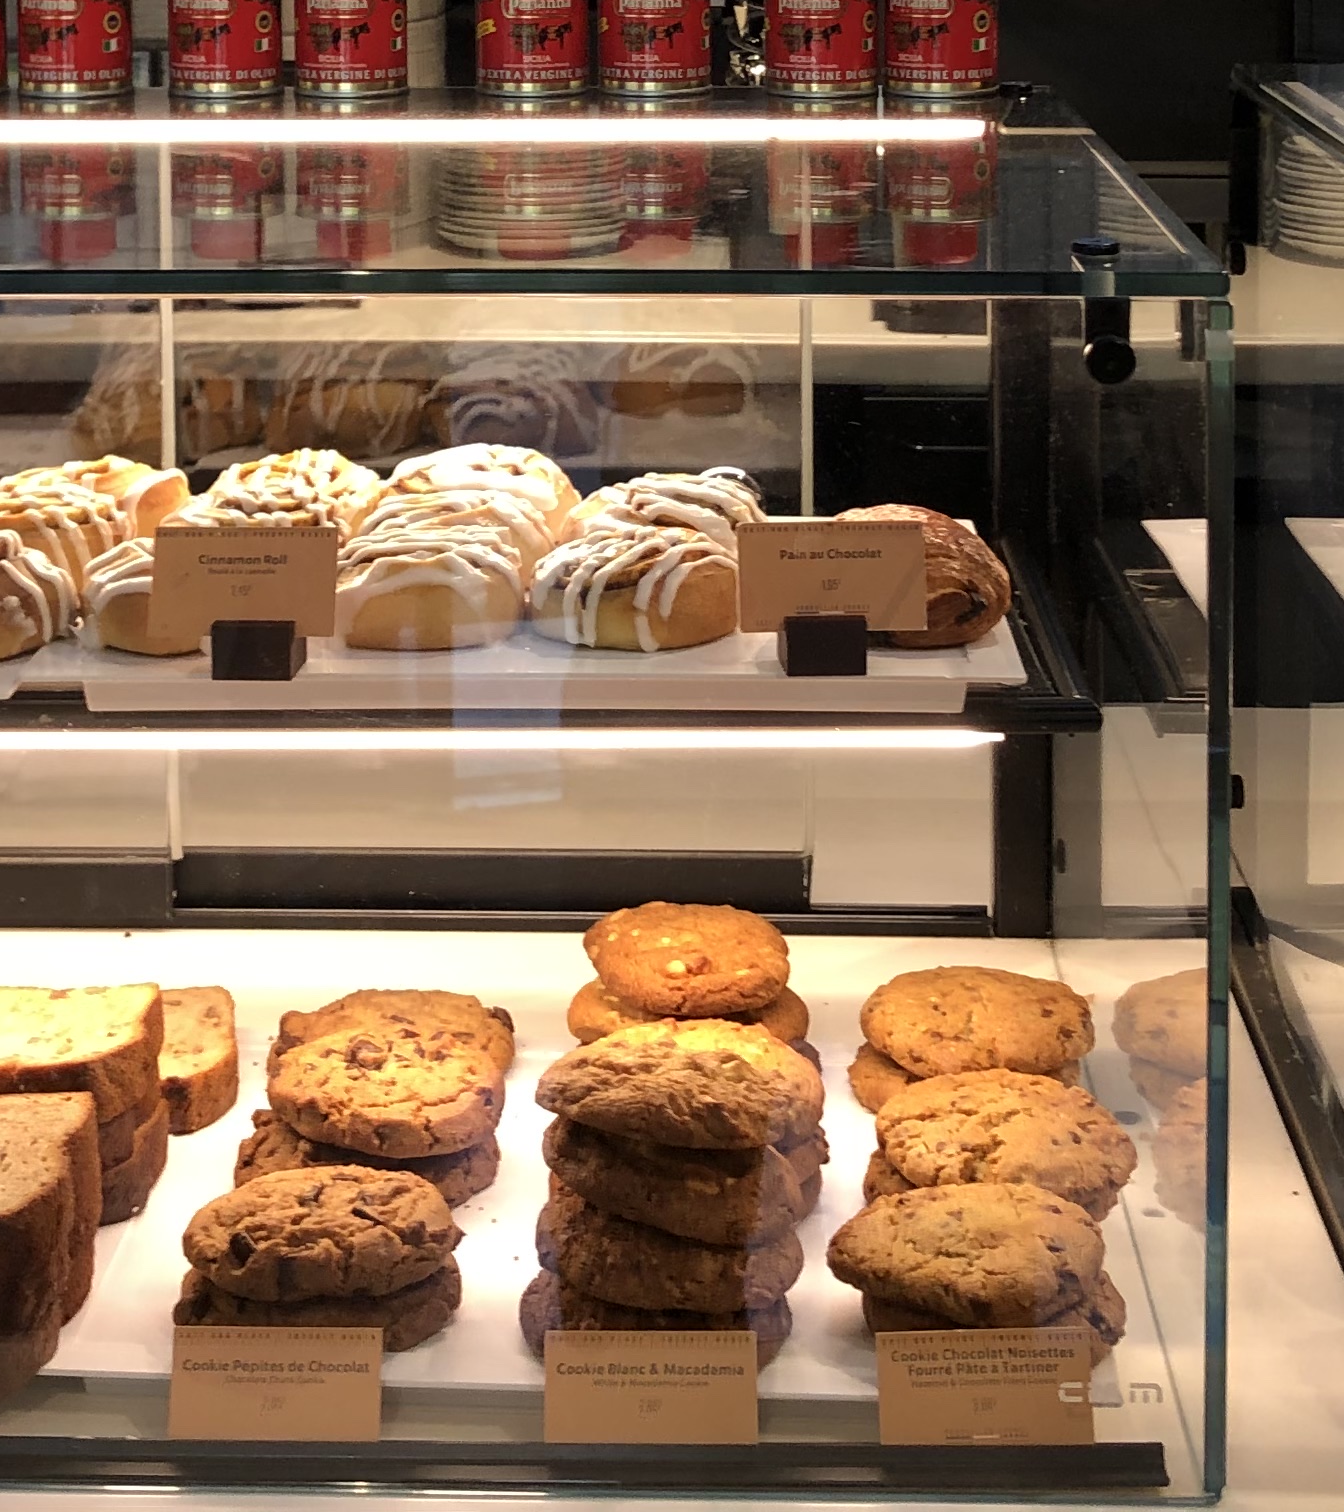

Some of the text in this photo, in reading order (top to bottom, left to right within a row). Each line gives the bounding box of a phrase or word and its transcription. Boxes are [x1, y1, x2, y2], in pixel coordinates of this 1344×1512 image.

[198, 554, 288, 565] Cinnamon Roll
[779, 548, 882, 560] Pain au Chocolat
[182, 1359, 229, 1372] Cookie
[287, 1360, 304, 1372] de
[308, 1360, 369, 1373] Chocolat
[557, 1363, 604, 1375] Cookie
[608, 1363, 645, 1375] Blanc
[663, 1363, 745, 1375] Macadamia
